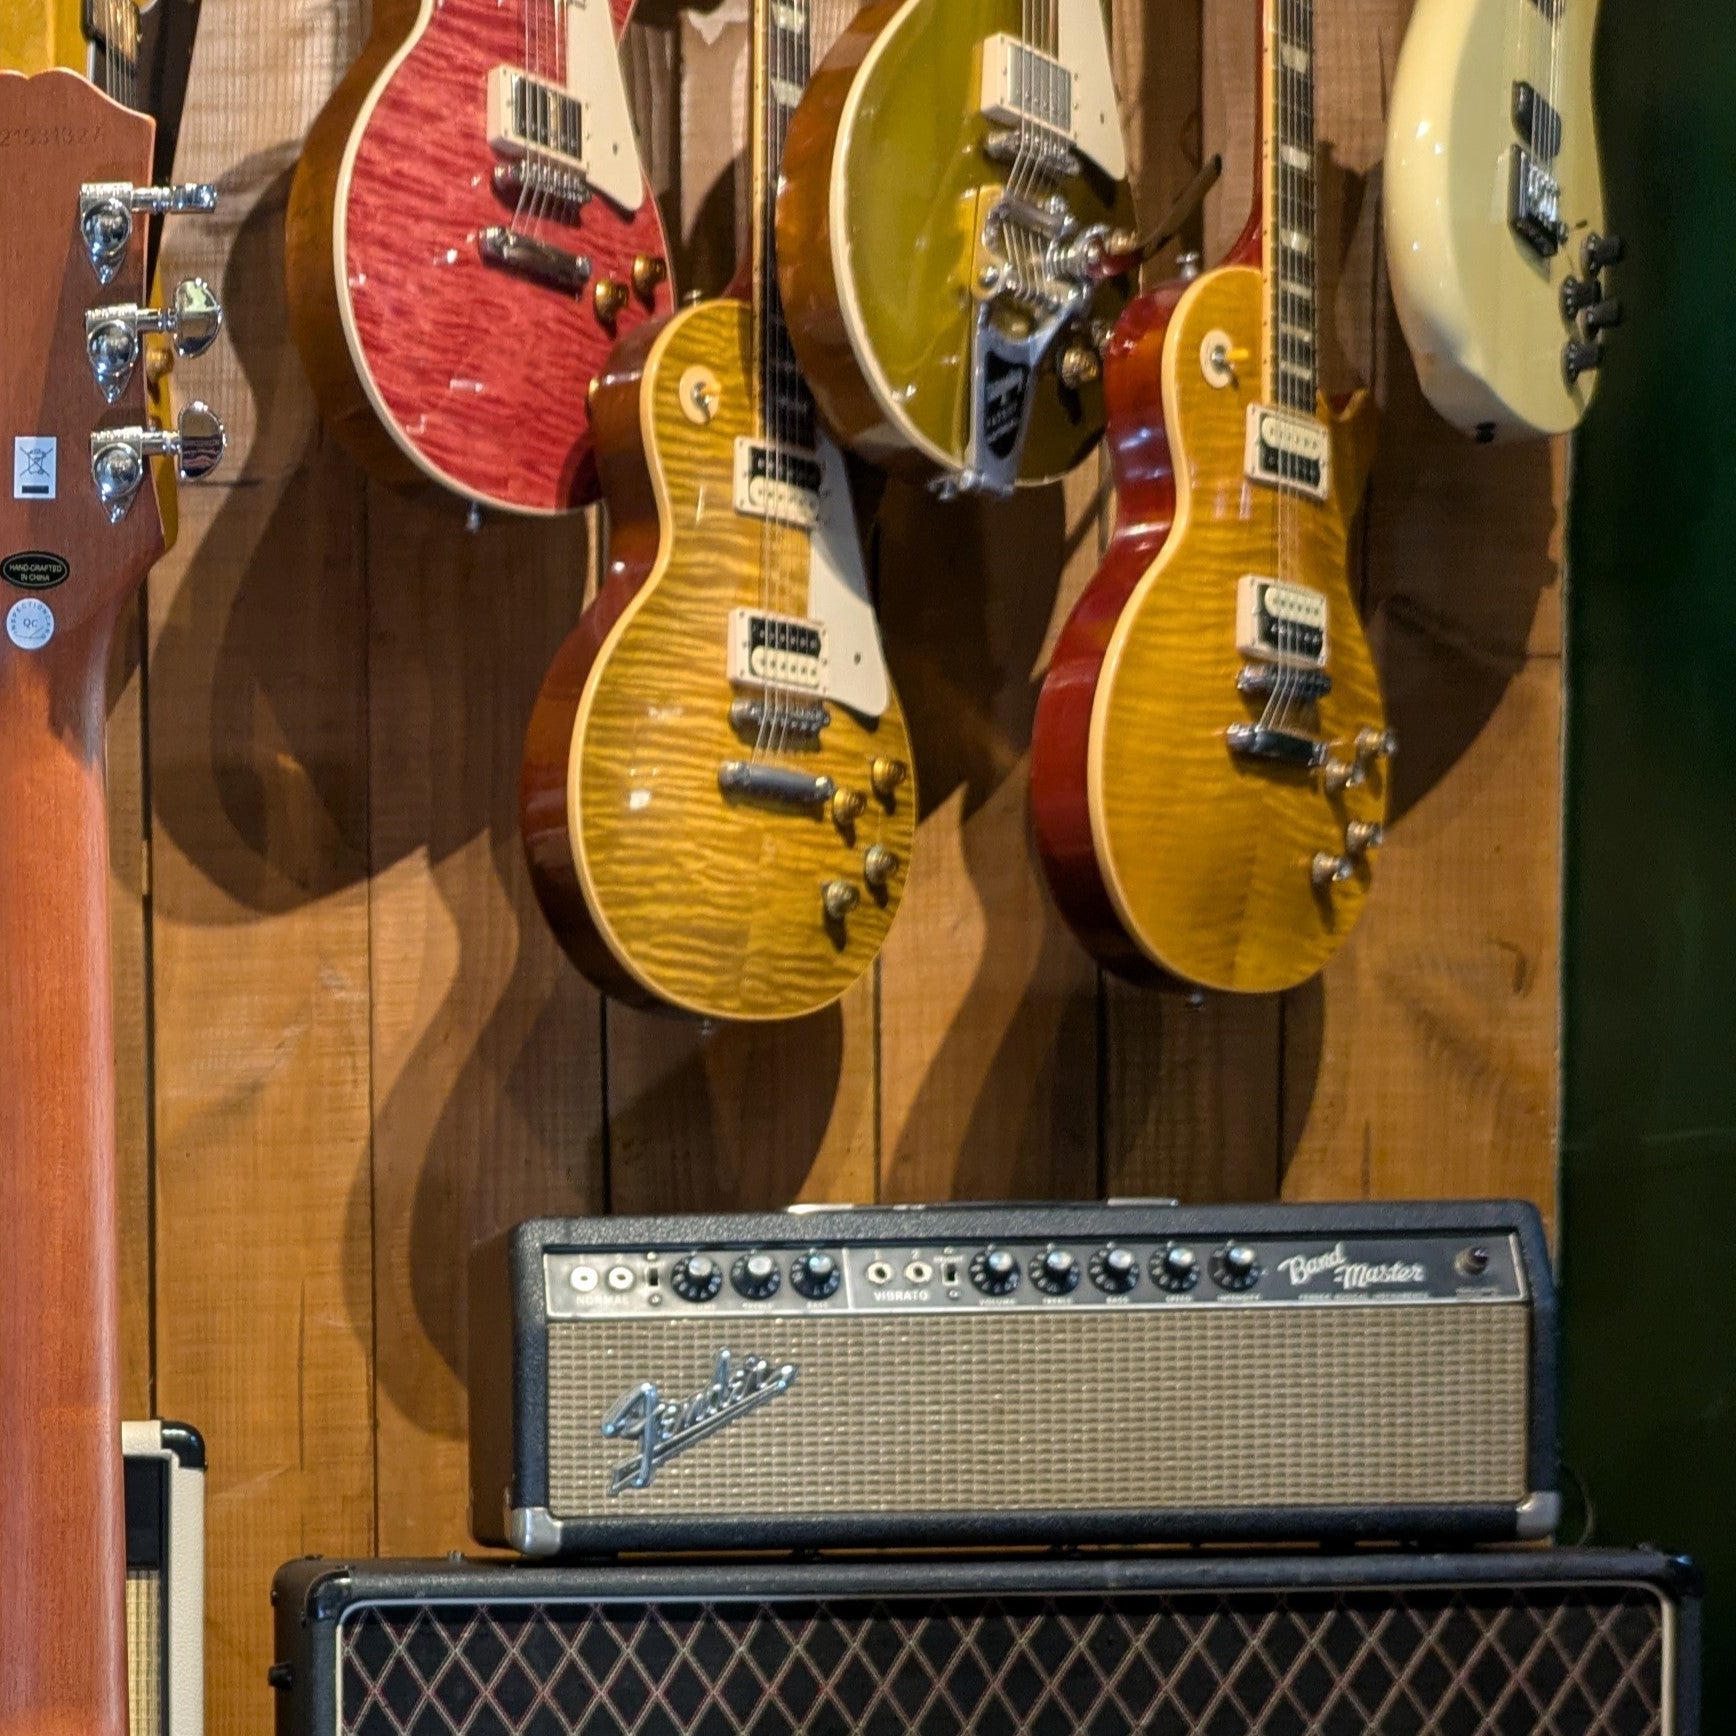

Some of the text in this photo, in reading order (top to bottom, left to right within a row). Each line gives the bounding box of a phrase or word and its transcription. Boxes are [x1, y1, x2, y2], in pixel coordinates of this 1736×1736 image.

[29, 573, 50, 582] CHINA
[23, 618, 38, 629] QC
[1277, 1241, 1427, 1290] Band Master
[874, 1290, 929, 1301] VIBRATO
[601, 1346, 798, 1497] Fender
